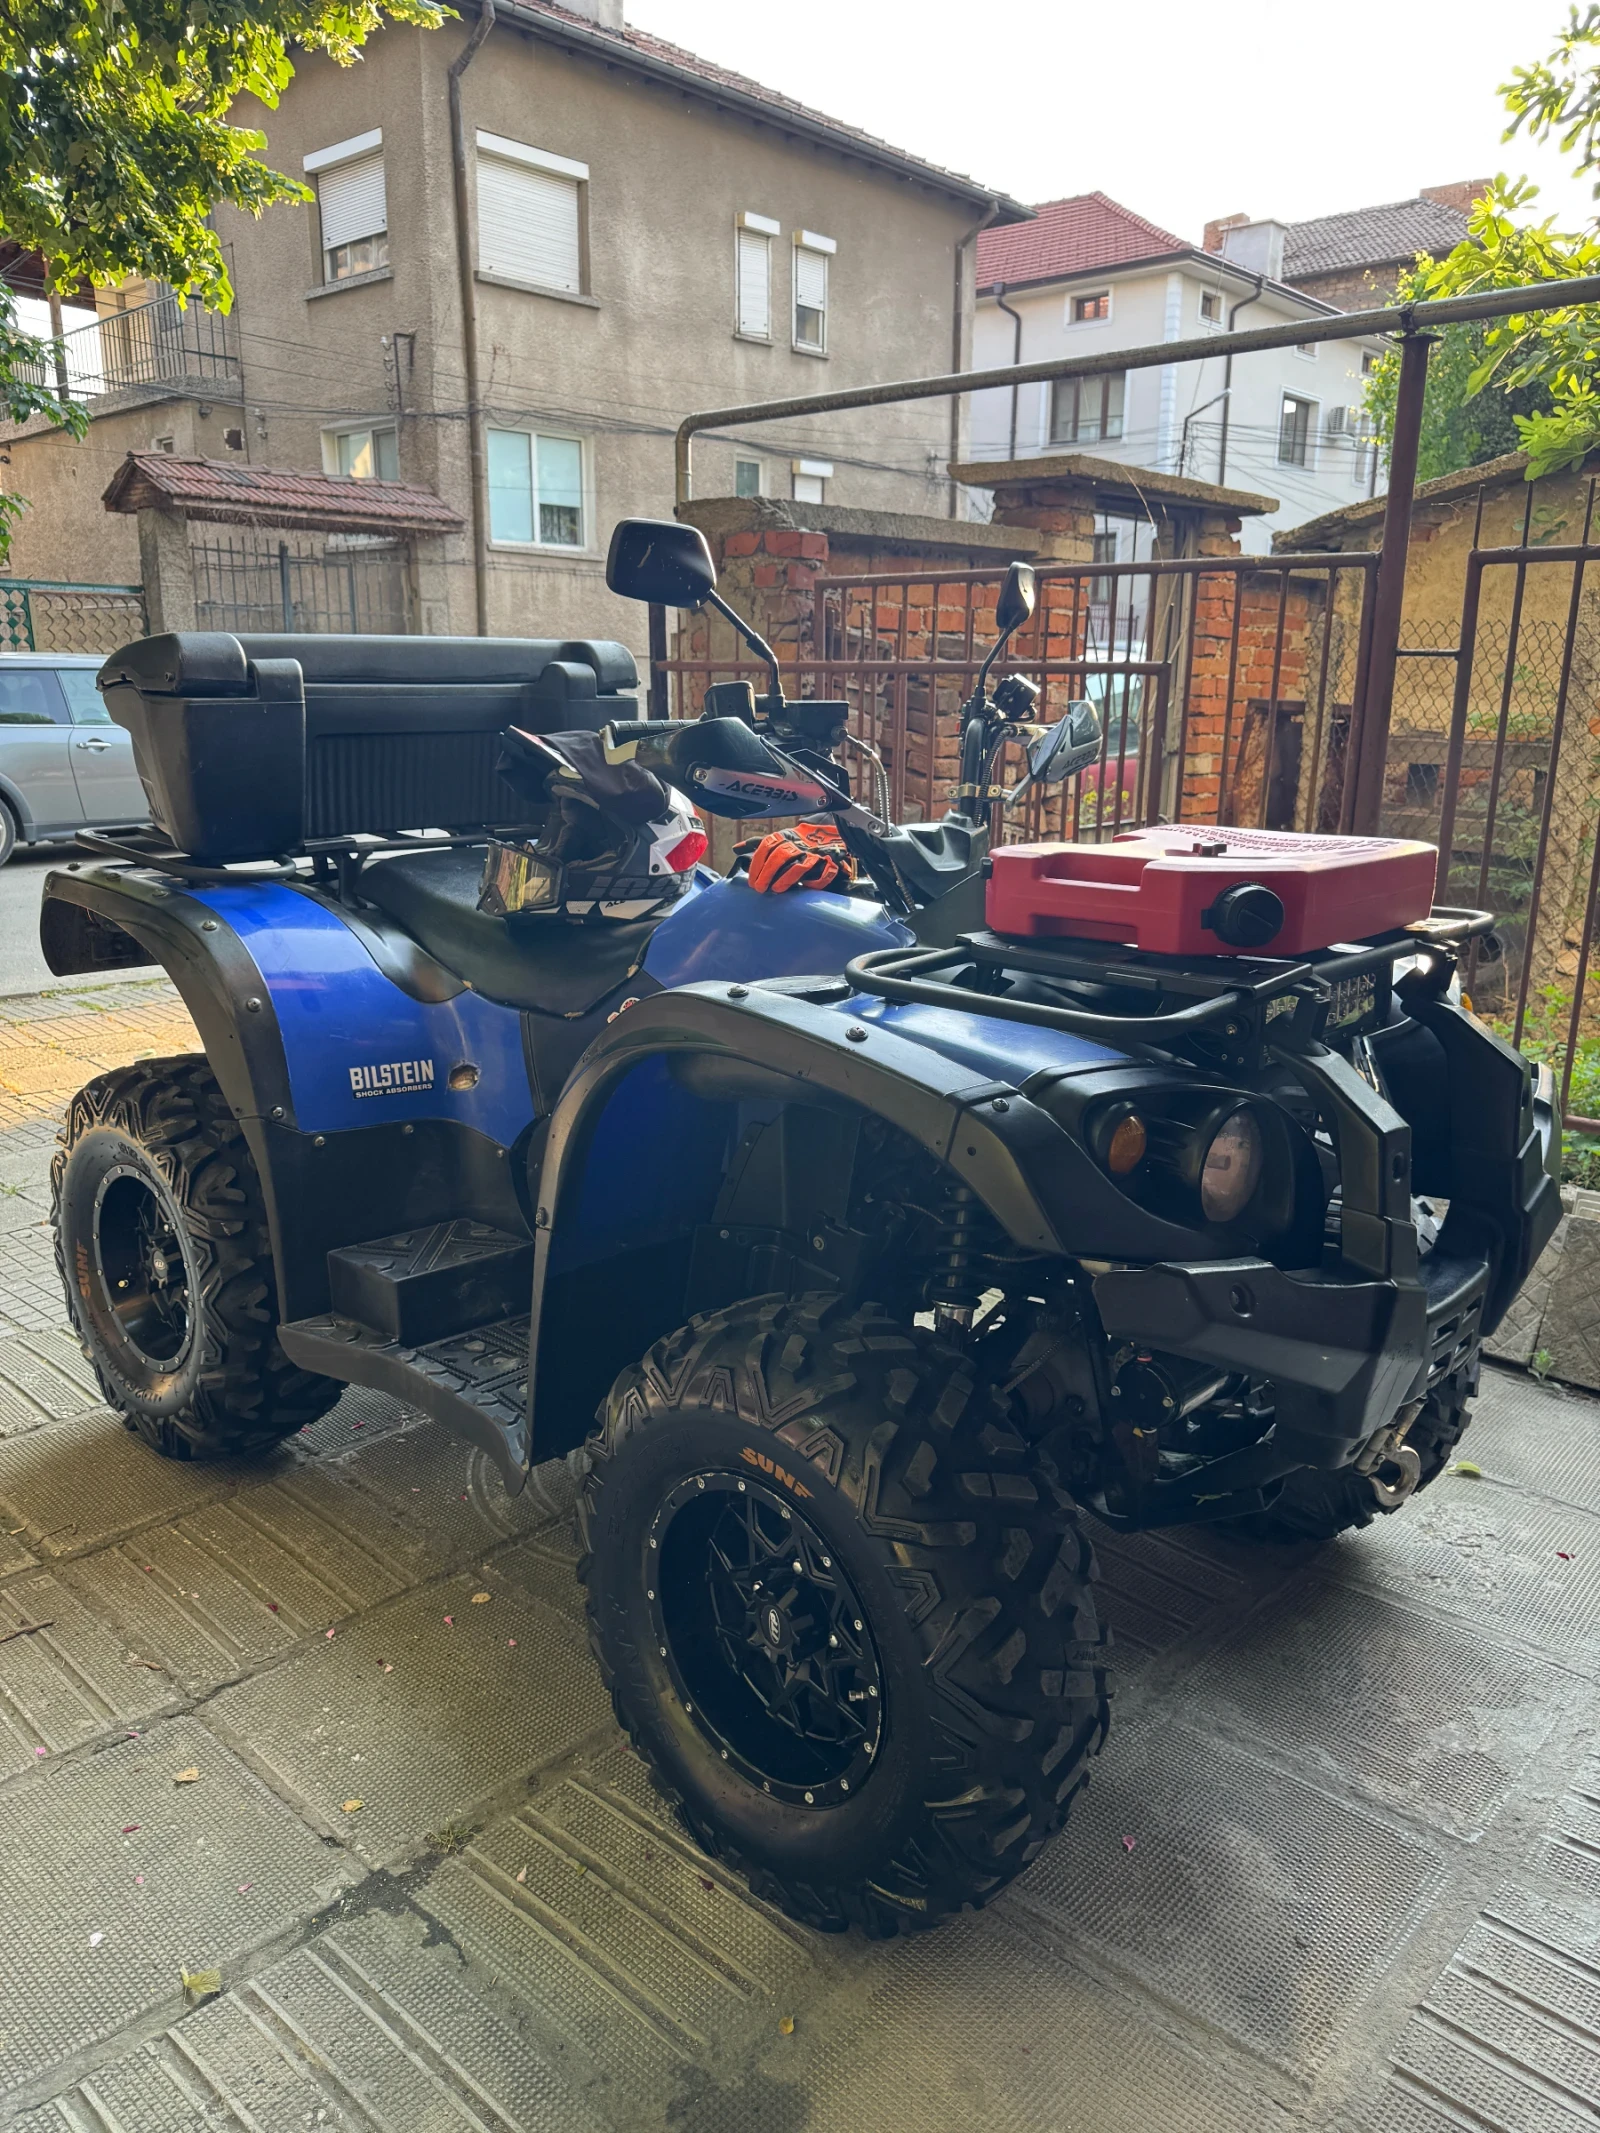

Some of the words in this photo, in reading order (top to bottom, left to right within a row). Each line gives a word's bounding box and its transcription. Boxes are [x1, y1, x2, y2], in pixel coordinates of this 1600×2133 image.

[725, 780, 799, 802] ACERBIS
[349, 1059, 435, 1091] BILSTEIN
[355, 1089, 384, 1099] SHOCK
[385, 1083, 433, 1095] ABSORBERS
[738, 1446, 816, 1499] SUNF
